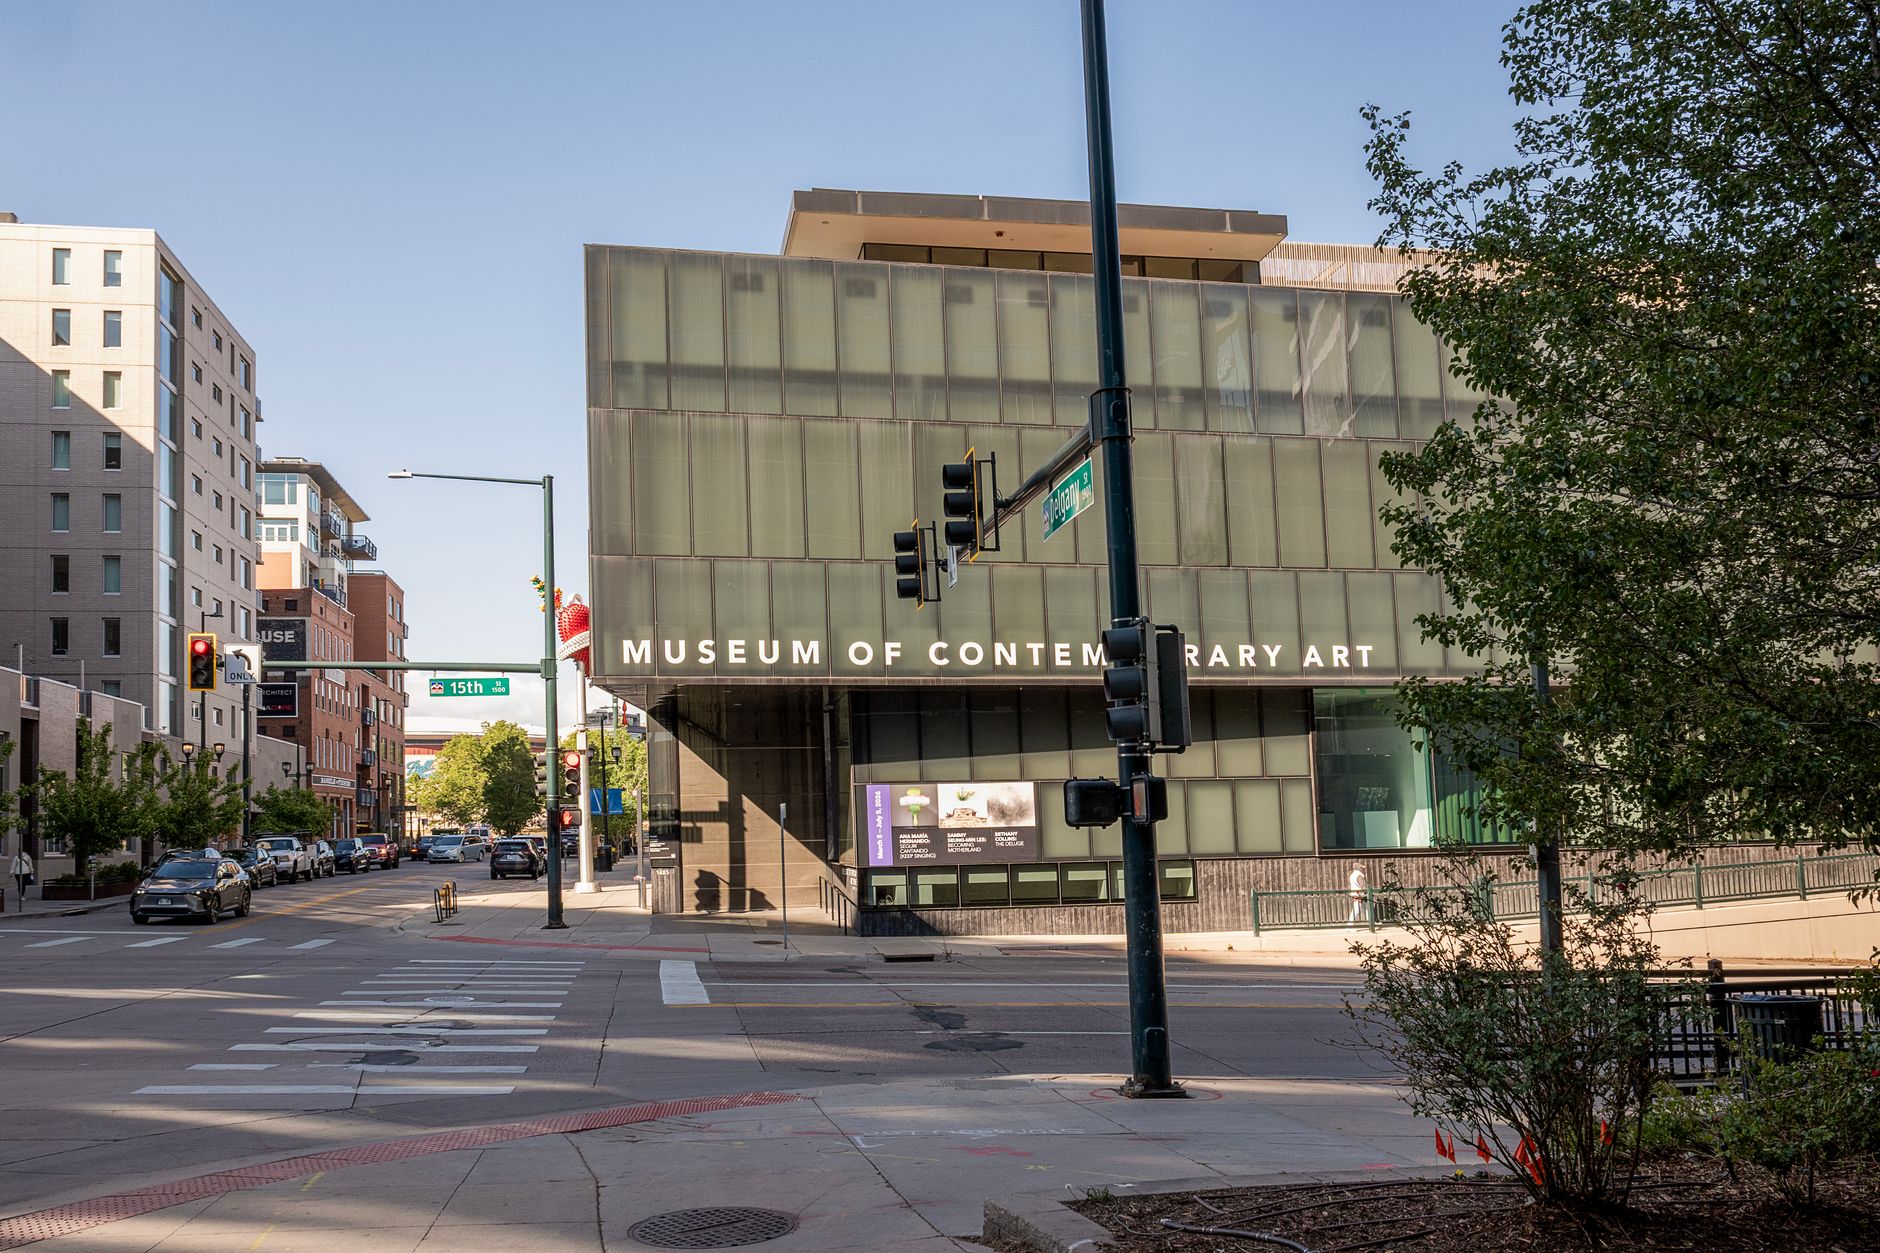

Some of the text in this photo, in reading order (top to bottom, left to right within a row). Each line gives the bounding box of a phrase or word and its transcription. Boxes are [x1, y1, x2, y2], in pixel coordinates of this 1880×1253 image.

[622, 639, 1373, 668] MUSEUM OF CONTEMRARY ART
[230, 672, 255, 681] ONLY
[450, 681, 483, 694] 15th
[875, 815, 884, 828] July
